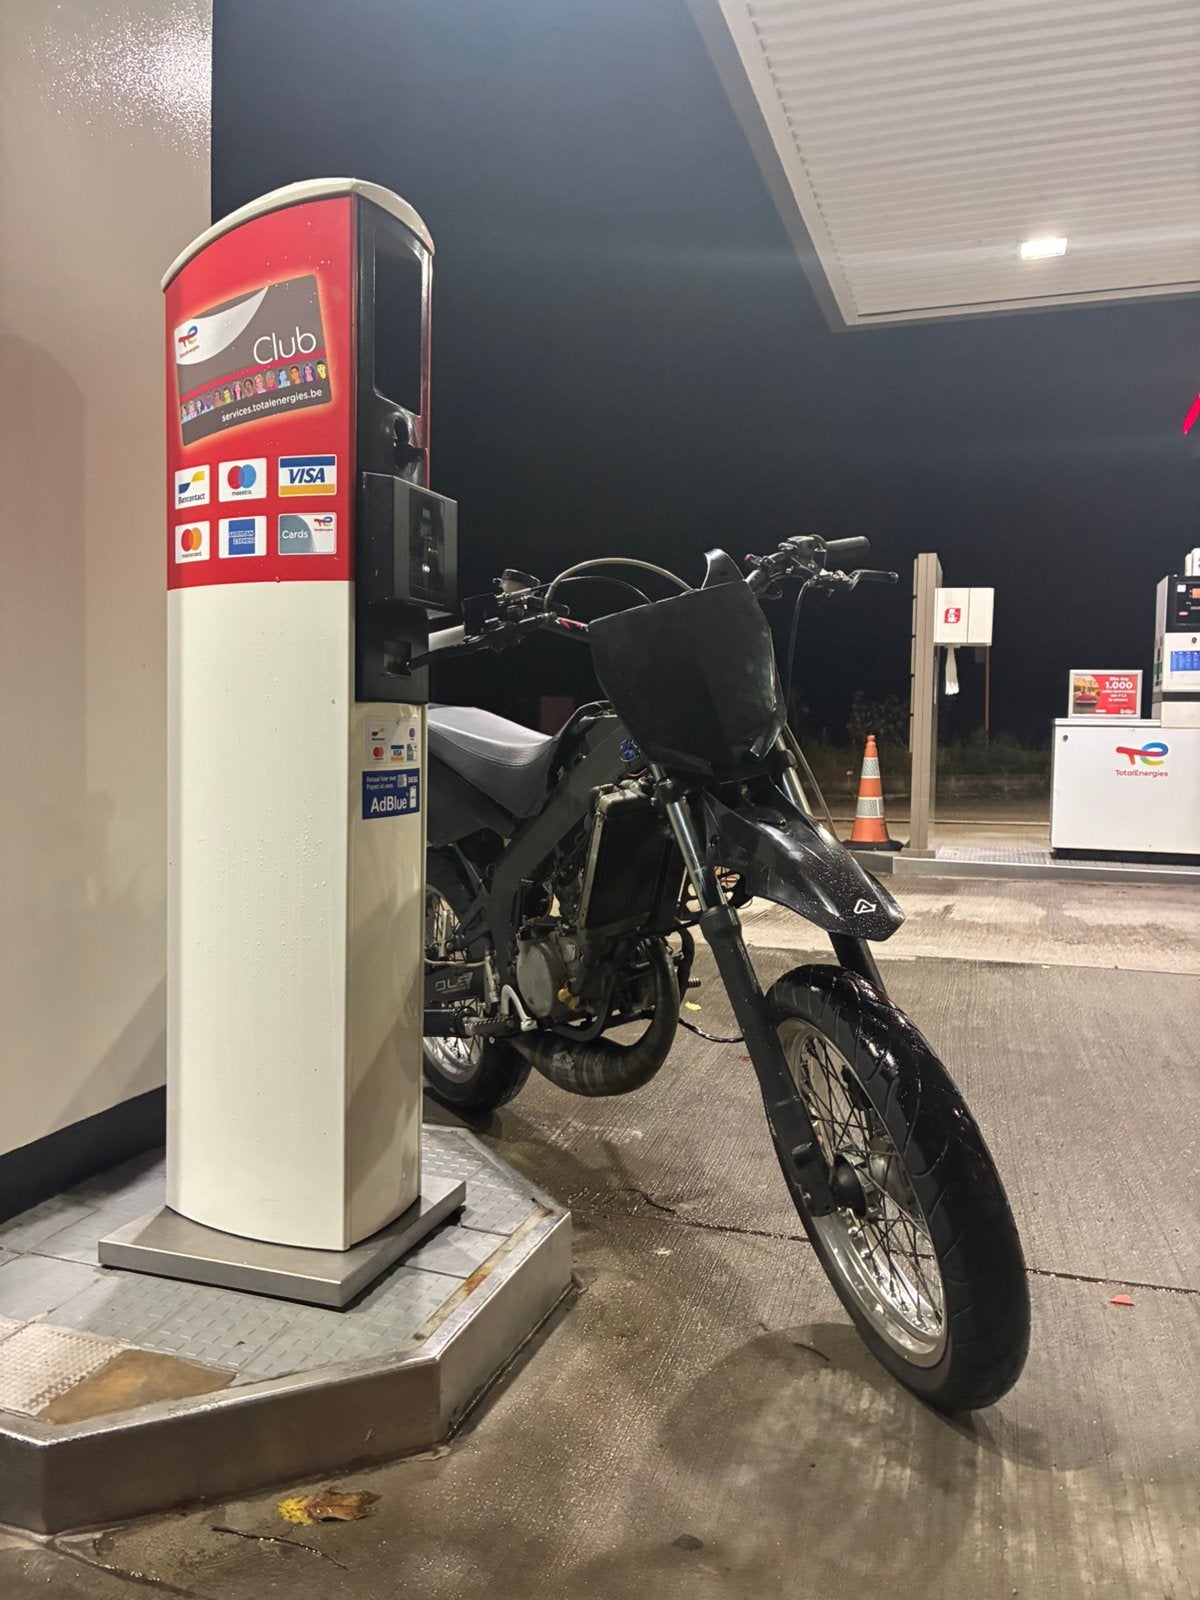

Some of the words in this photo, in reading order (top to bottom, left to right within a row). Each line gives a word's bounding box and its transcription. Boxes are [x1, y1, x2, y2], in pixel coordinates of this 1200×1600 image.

[253, 326, 317, 364] Club
[221, 389, 323, 423] services.totalenergies.be
[287, 467, 325, 484] VISA
[178, 492, 206, 505] Bancontact
[281, 529, 309, 540] Cards
[1105, 681, 1133, 689] 1.000
[1115, 769, 1169, 778] TotalEnergies
[370, 795, 408, 813] AdBlue
